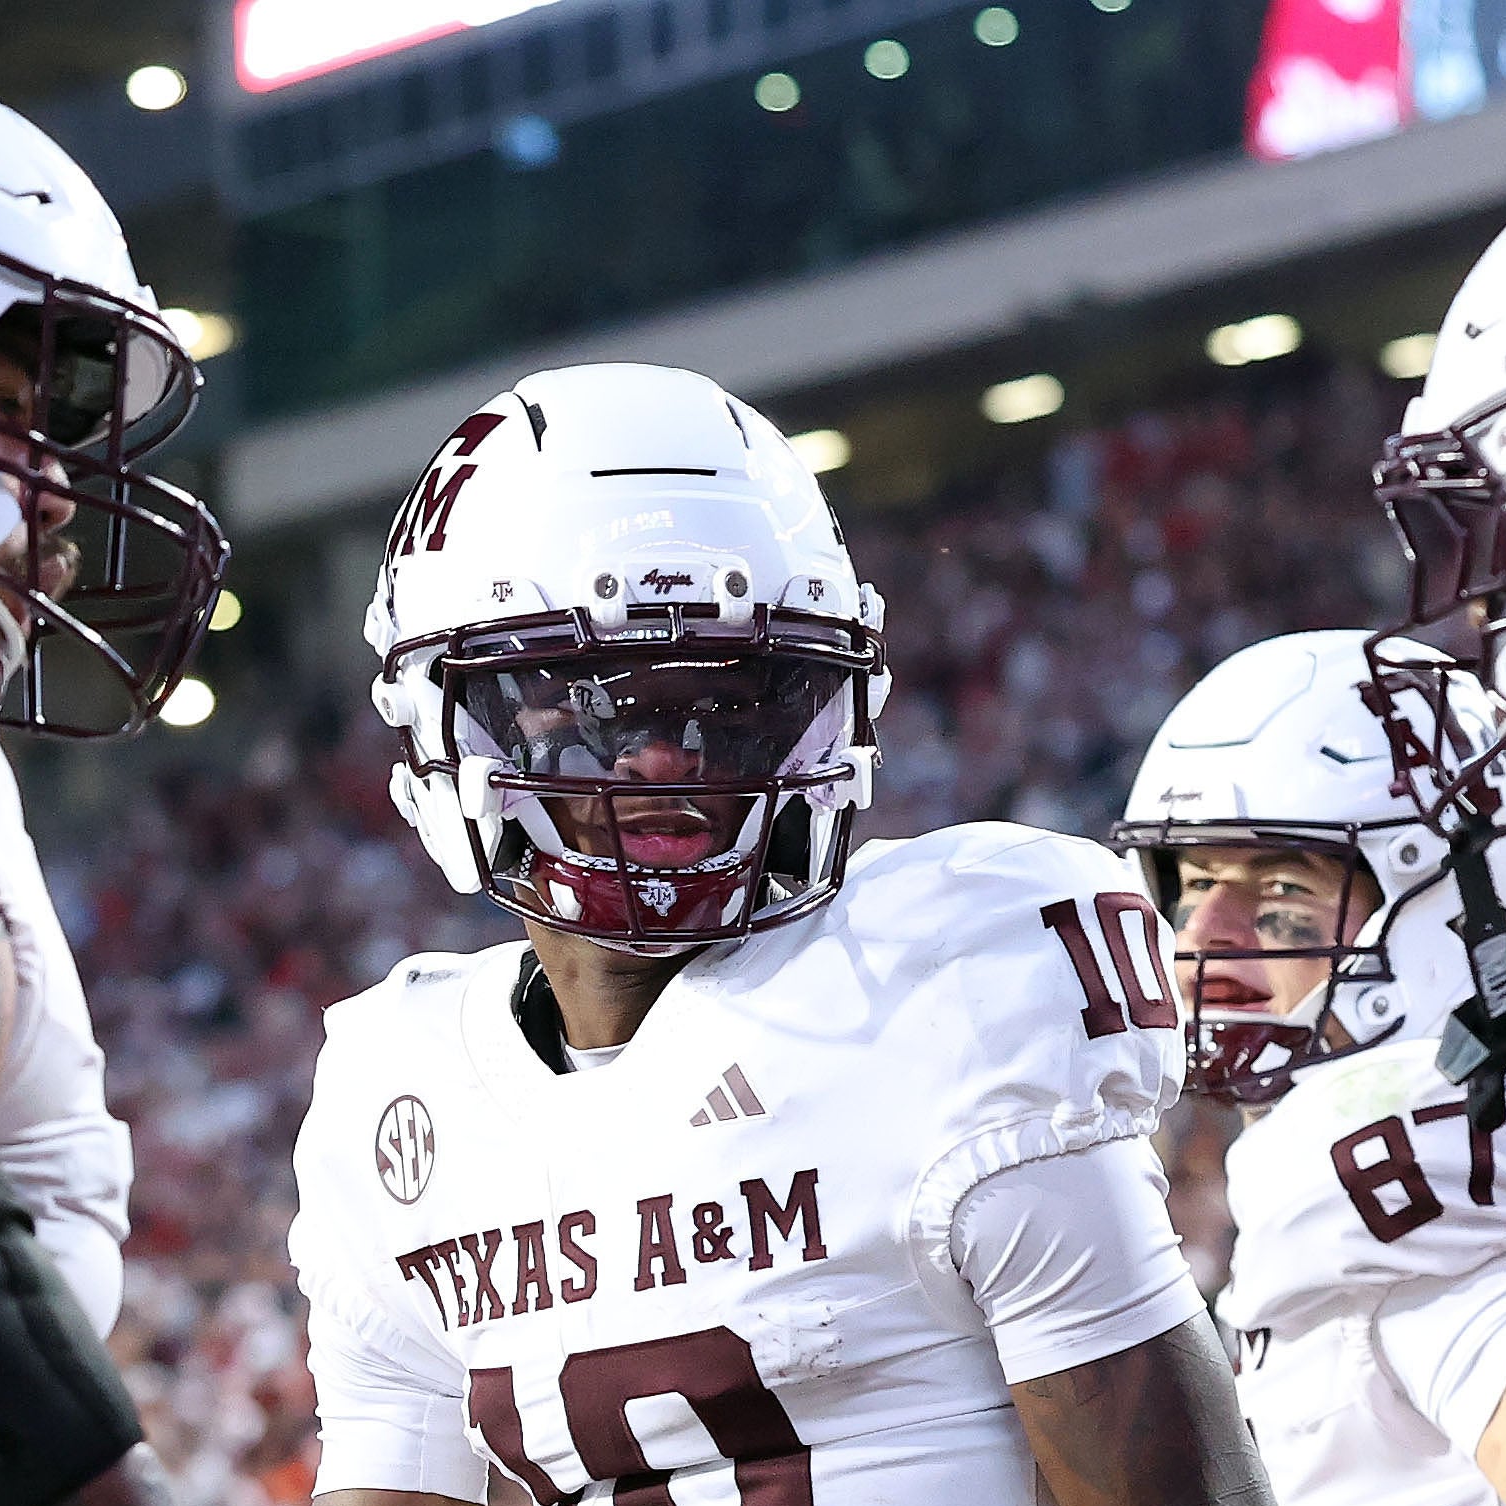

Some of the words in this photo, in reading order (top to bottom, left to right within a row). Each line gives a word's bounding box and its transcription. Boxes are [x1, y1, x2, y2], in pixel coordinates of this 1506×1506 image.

[1041, 892, 1179, 1040] 10
[377, 1096, 434, 1203] SEC
[1330, 1100, 1494, 1244] 87
[397, 1209, 599, 1332] TEXAS
[633, 1168, 829, 1293] A&M
